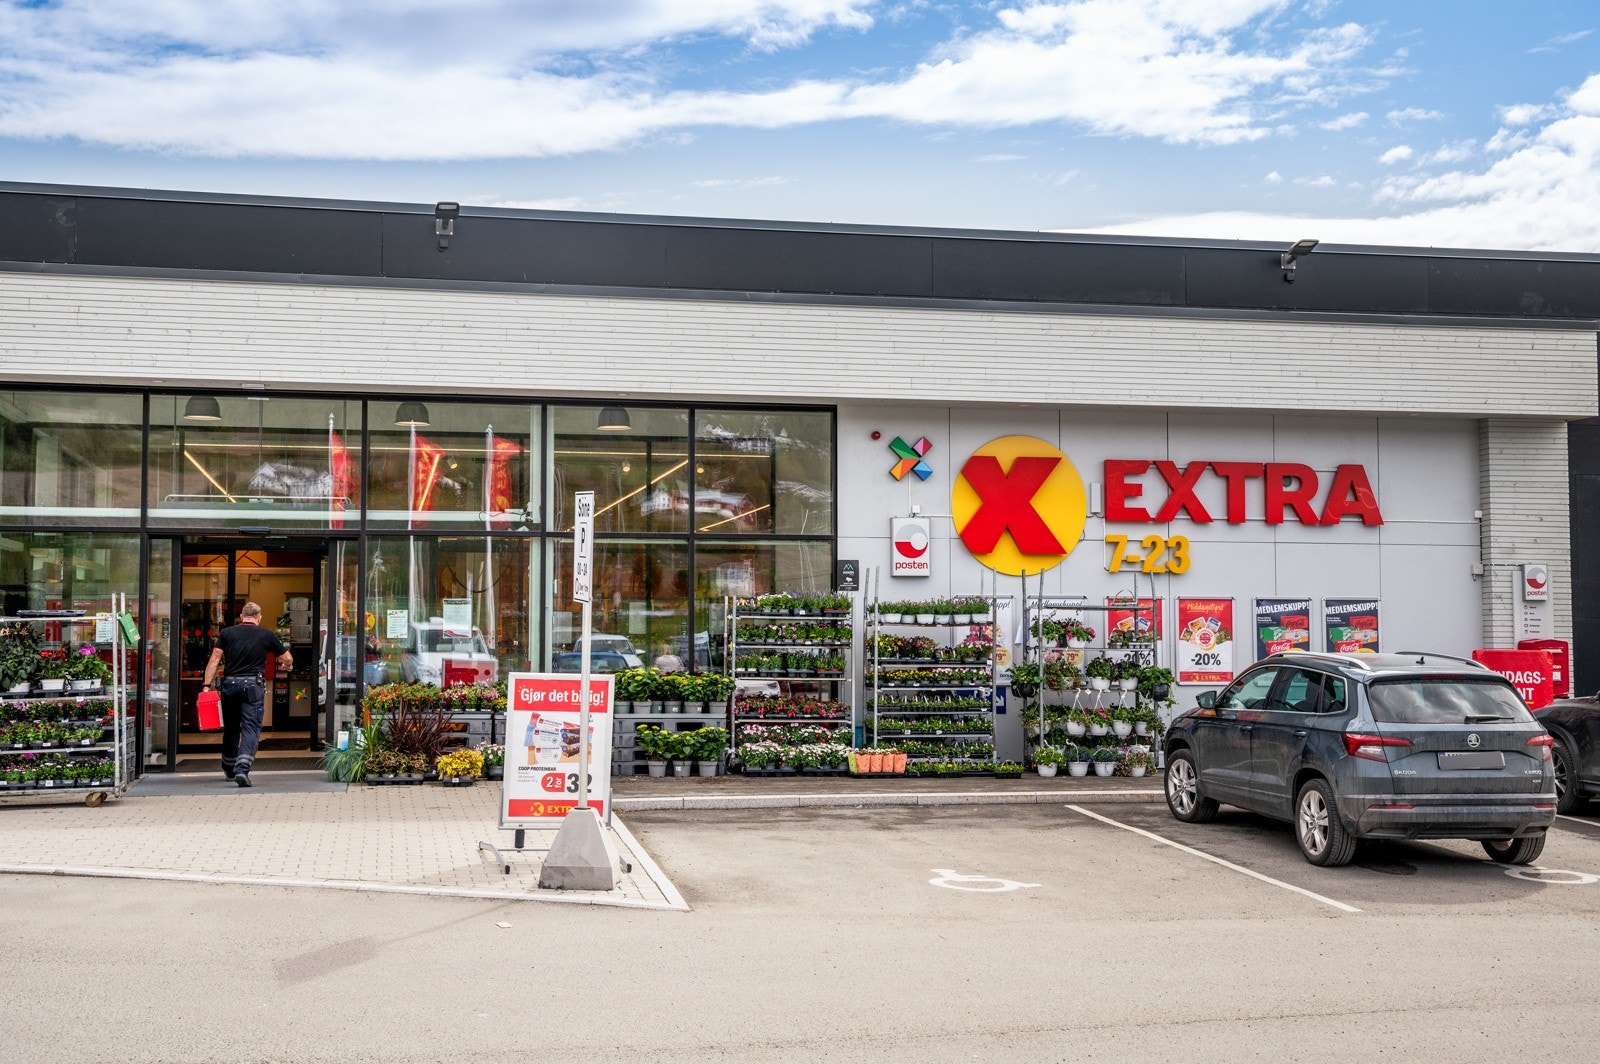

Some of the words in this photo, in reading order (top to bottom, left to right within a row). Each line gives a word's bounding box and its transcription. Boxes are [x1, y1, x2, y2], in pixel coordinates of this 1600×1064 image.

[1104, 459, 1384, 525] EXTRA
[1105, 534, 1191, 574] 7-23
[895, 561, 928, 571] posten
[1256, 601, 1309, 615] MEDLEMSKUPP!
[1326, 602, 1379, 615] MEDLEMSKUPP!
[1191, 653, 1221, 666] -20%
[520, 688, 546, 704] Gjør
[548, 689, 569, 702] det
[571, 690, 604, 706] biig!
[546, 777, 553, 788] 2
[547, 805, 573, 814] EXTR
